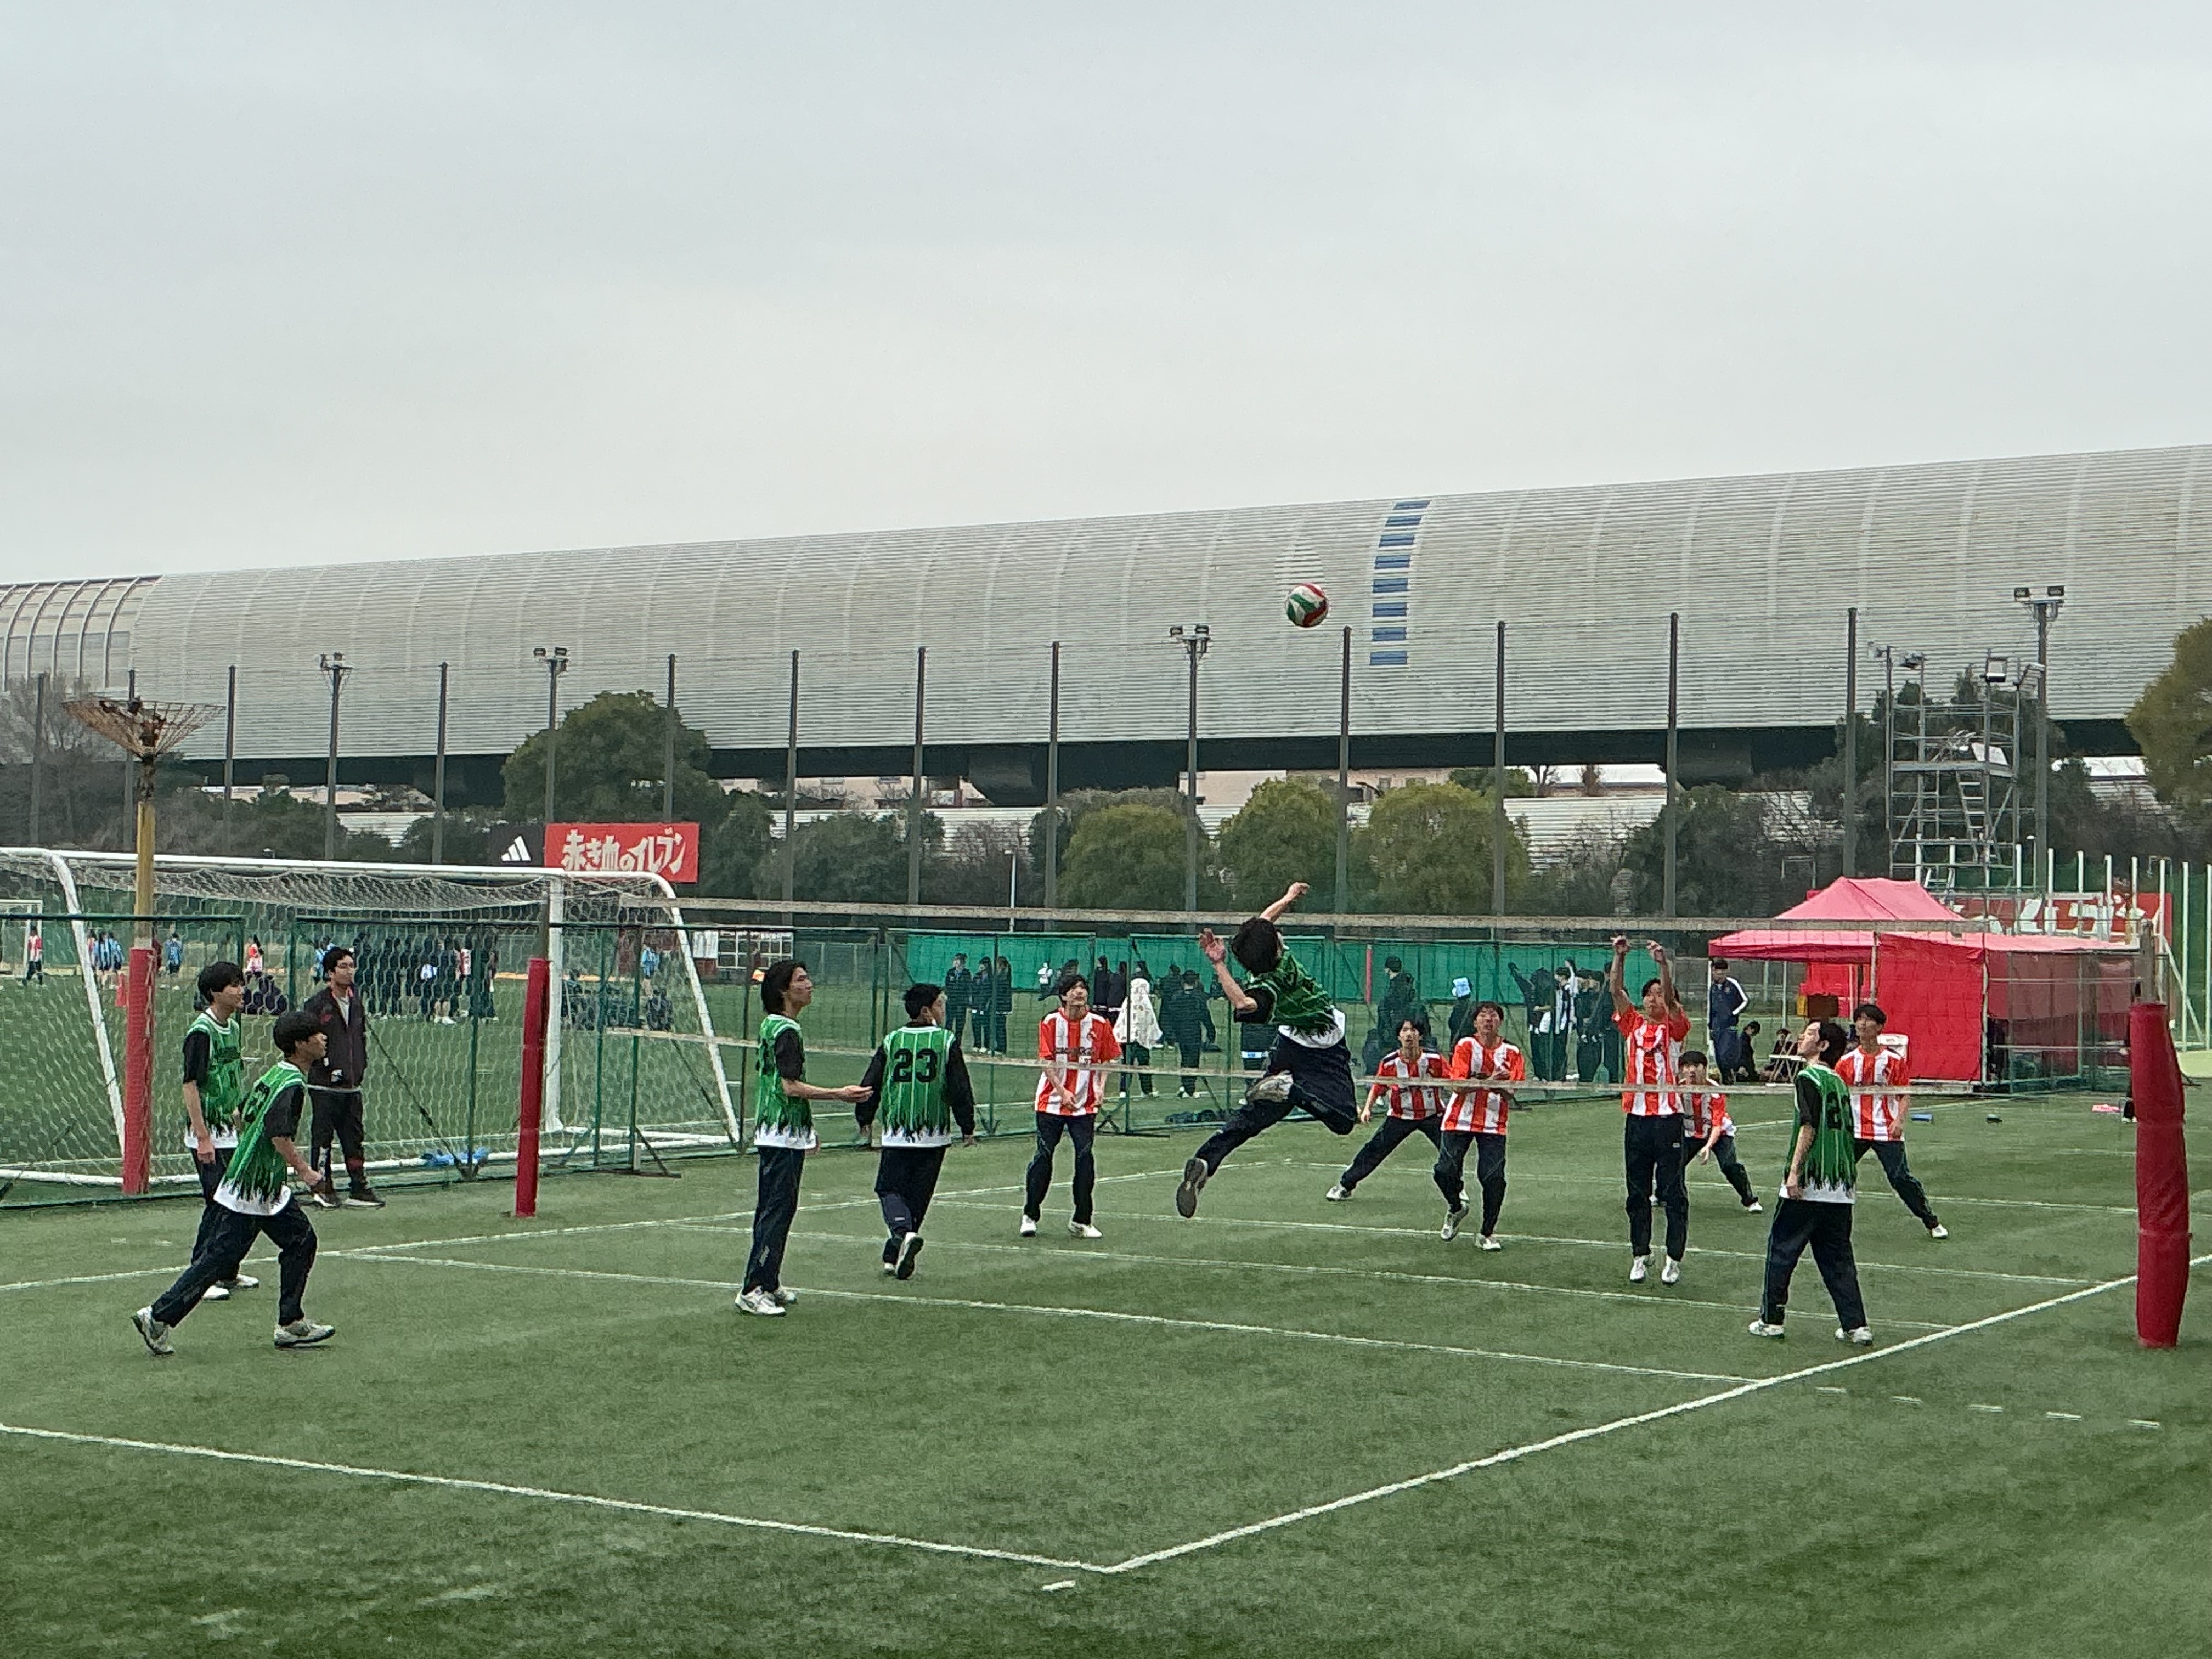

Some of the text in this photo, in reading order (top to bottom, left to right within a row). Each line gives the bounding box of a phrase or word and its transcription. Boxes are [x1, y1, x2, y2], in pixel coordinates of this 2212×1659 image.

[561, 827, 686, 875] 赤き血のイレブン
[893, 1048, 938, 1082] 23
